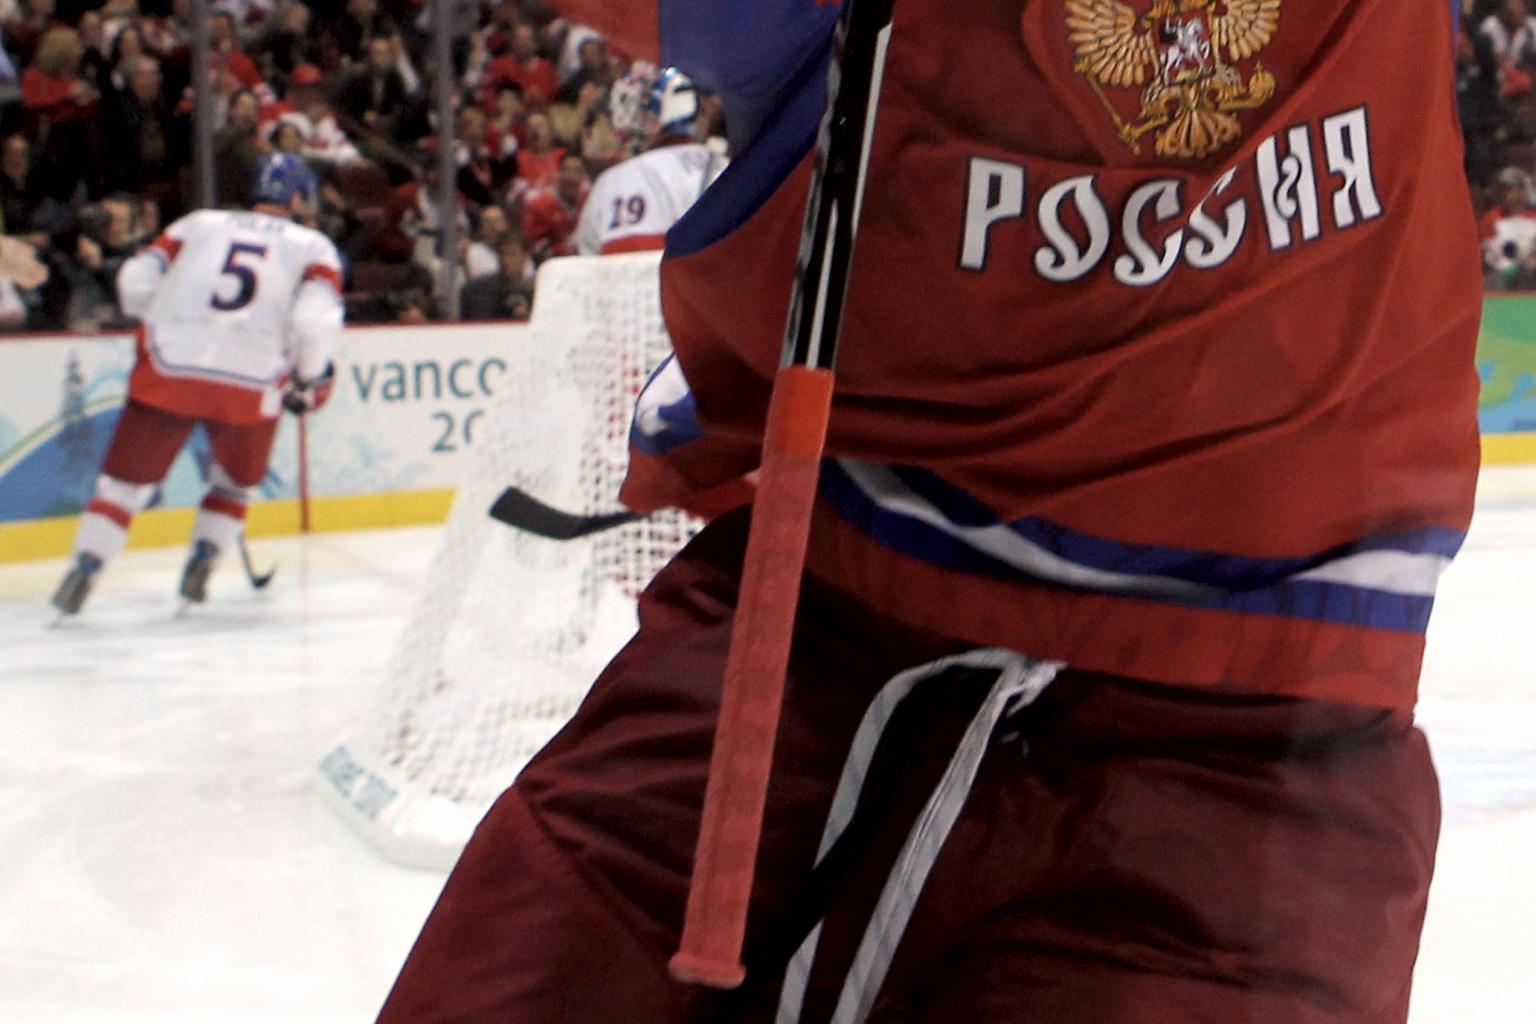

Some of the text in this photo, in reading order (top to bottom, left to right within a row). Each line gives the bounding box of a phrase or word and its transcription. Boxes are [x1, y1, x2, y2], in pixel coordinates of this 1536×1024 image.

[608, 195, 647, 230] 19
[958, 104, 1384, 287] РОССИЯ
[208, 238, 270, 312] 5
